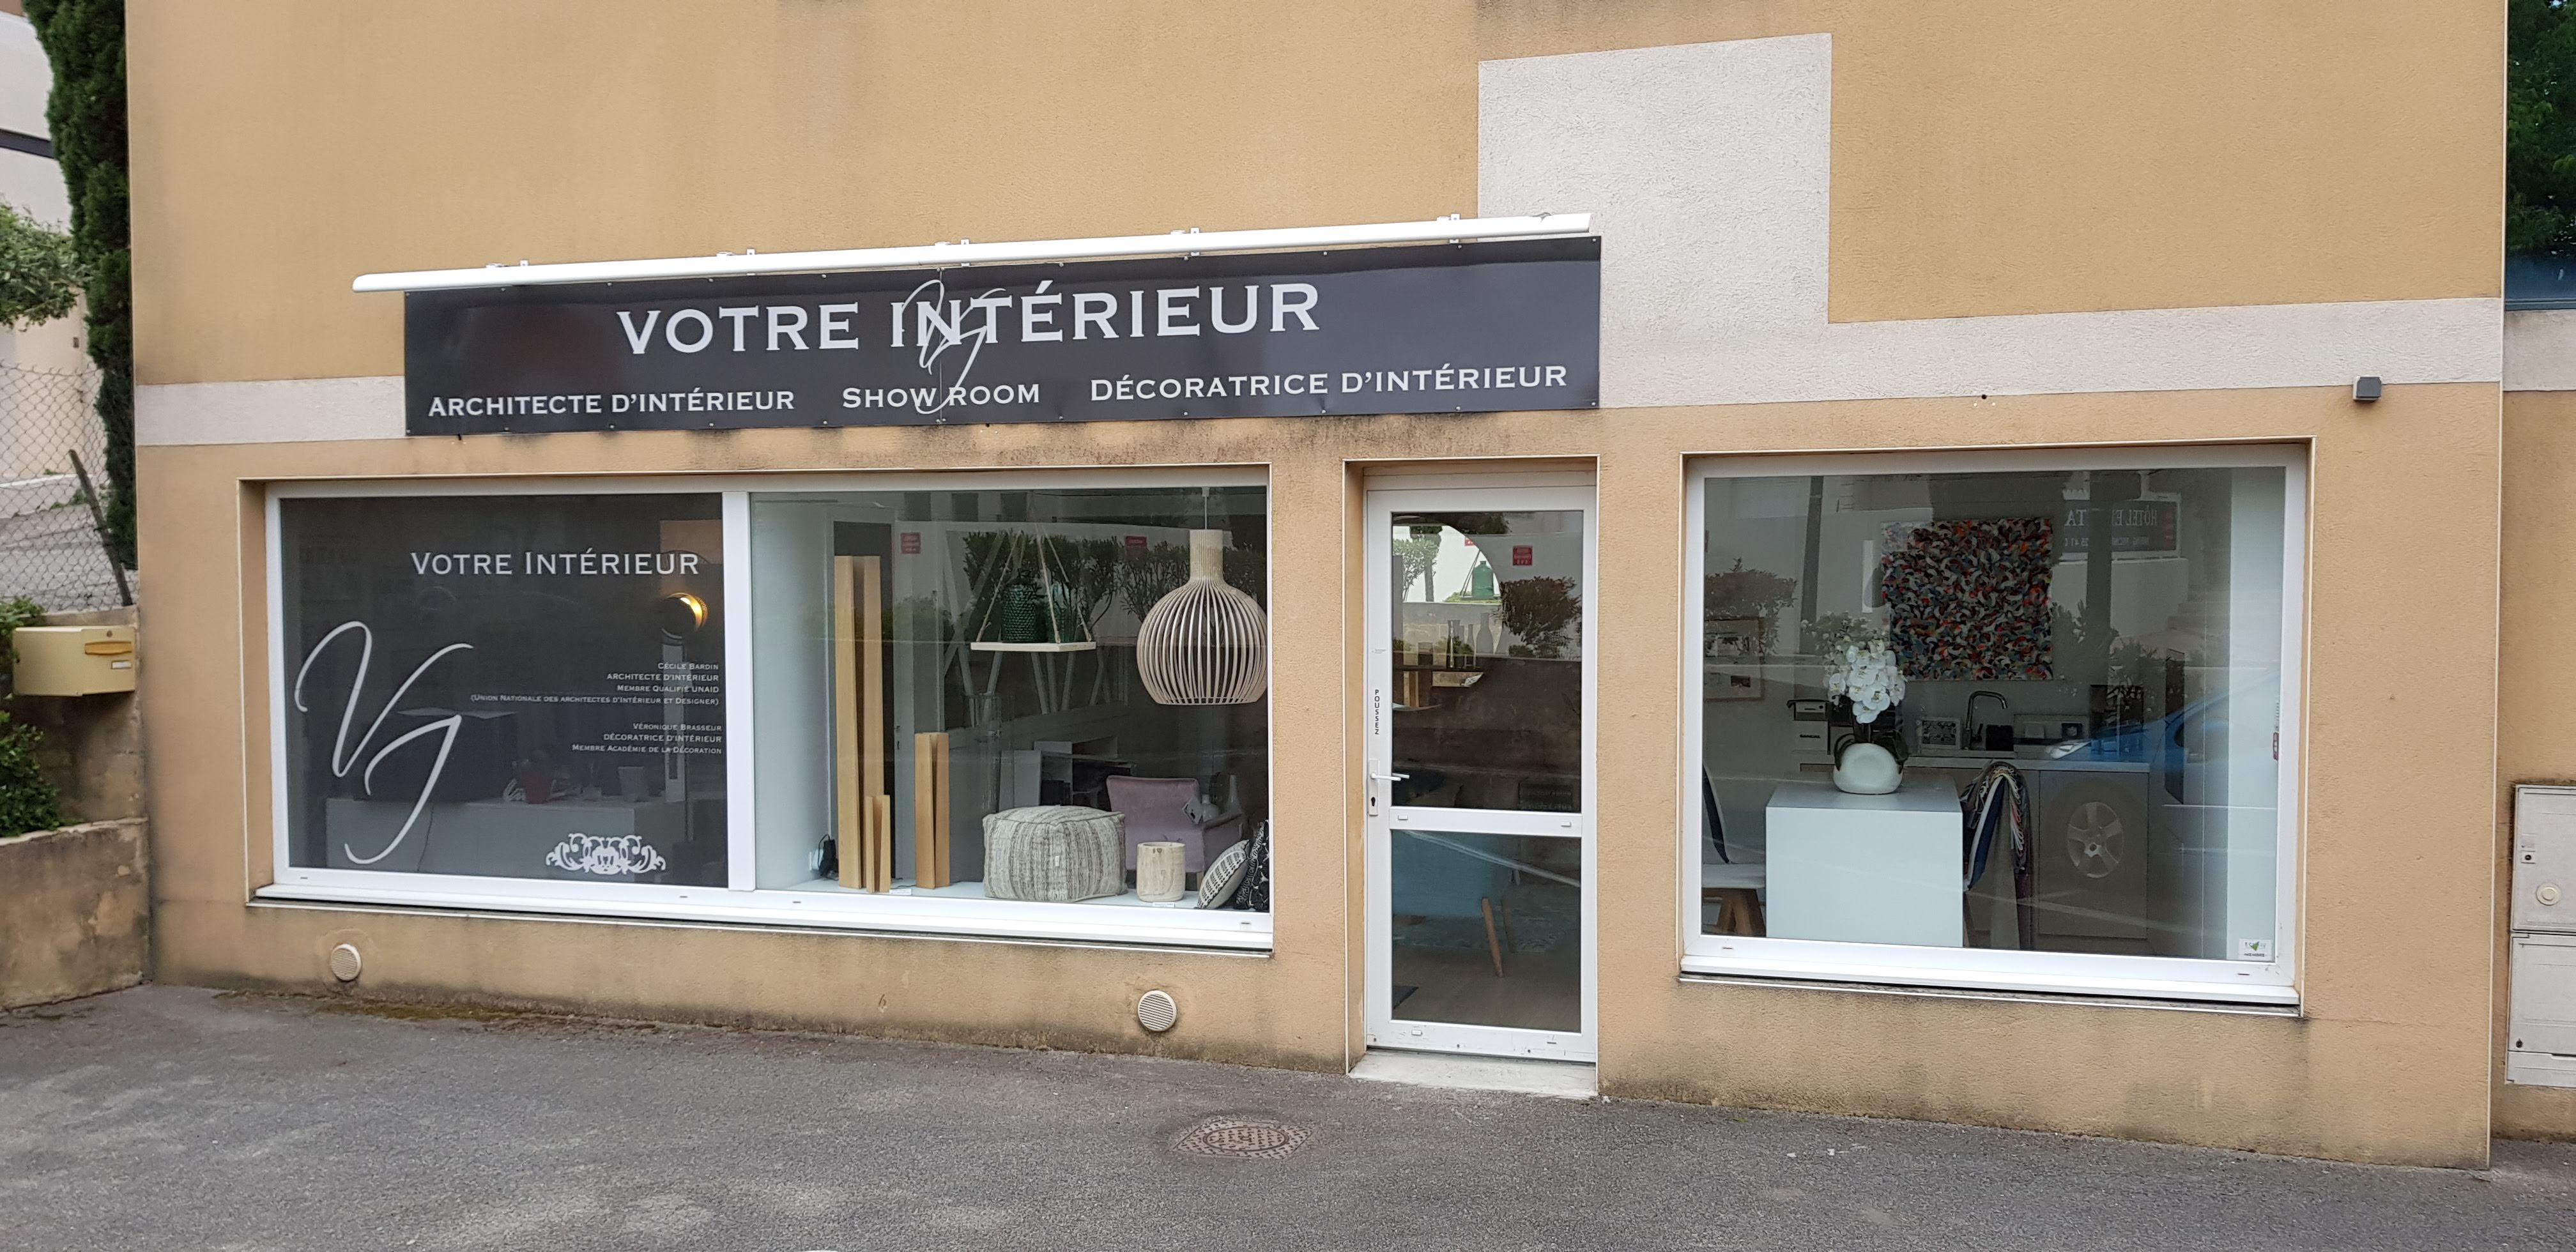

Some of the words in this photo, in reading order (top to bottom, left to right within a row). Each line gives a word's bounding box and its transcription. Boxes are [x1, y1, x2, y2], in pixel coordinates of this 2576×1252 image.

[617, 302, 859, 355] VOTRE
[890, 280, 1319, 348] INTÉRIEUR
[948, 383, 1040, 407] ROOM
[1090, 373, 1328, 402] DÉCORATRICE
[1342, 362, 1567, 393] D’INTÉRIEUR
[428, 393, 602, 418] ARCHITECTE
[611, 387, 794, 413] D’INTÉRIEUR
[411, 552, 512, 575] VOTRE
[525, 547, 700, 575] INTÉRIEUR
[657, 661, 687, 670] CÉCILE
[603, 733, 664, 742] DÉCORATRICE
[607, 744, 646, 752] ACADÉMIE
